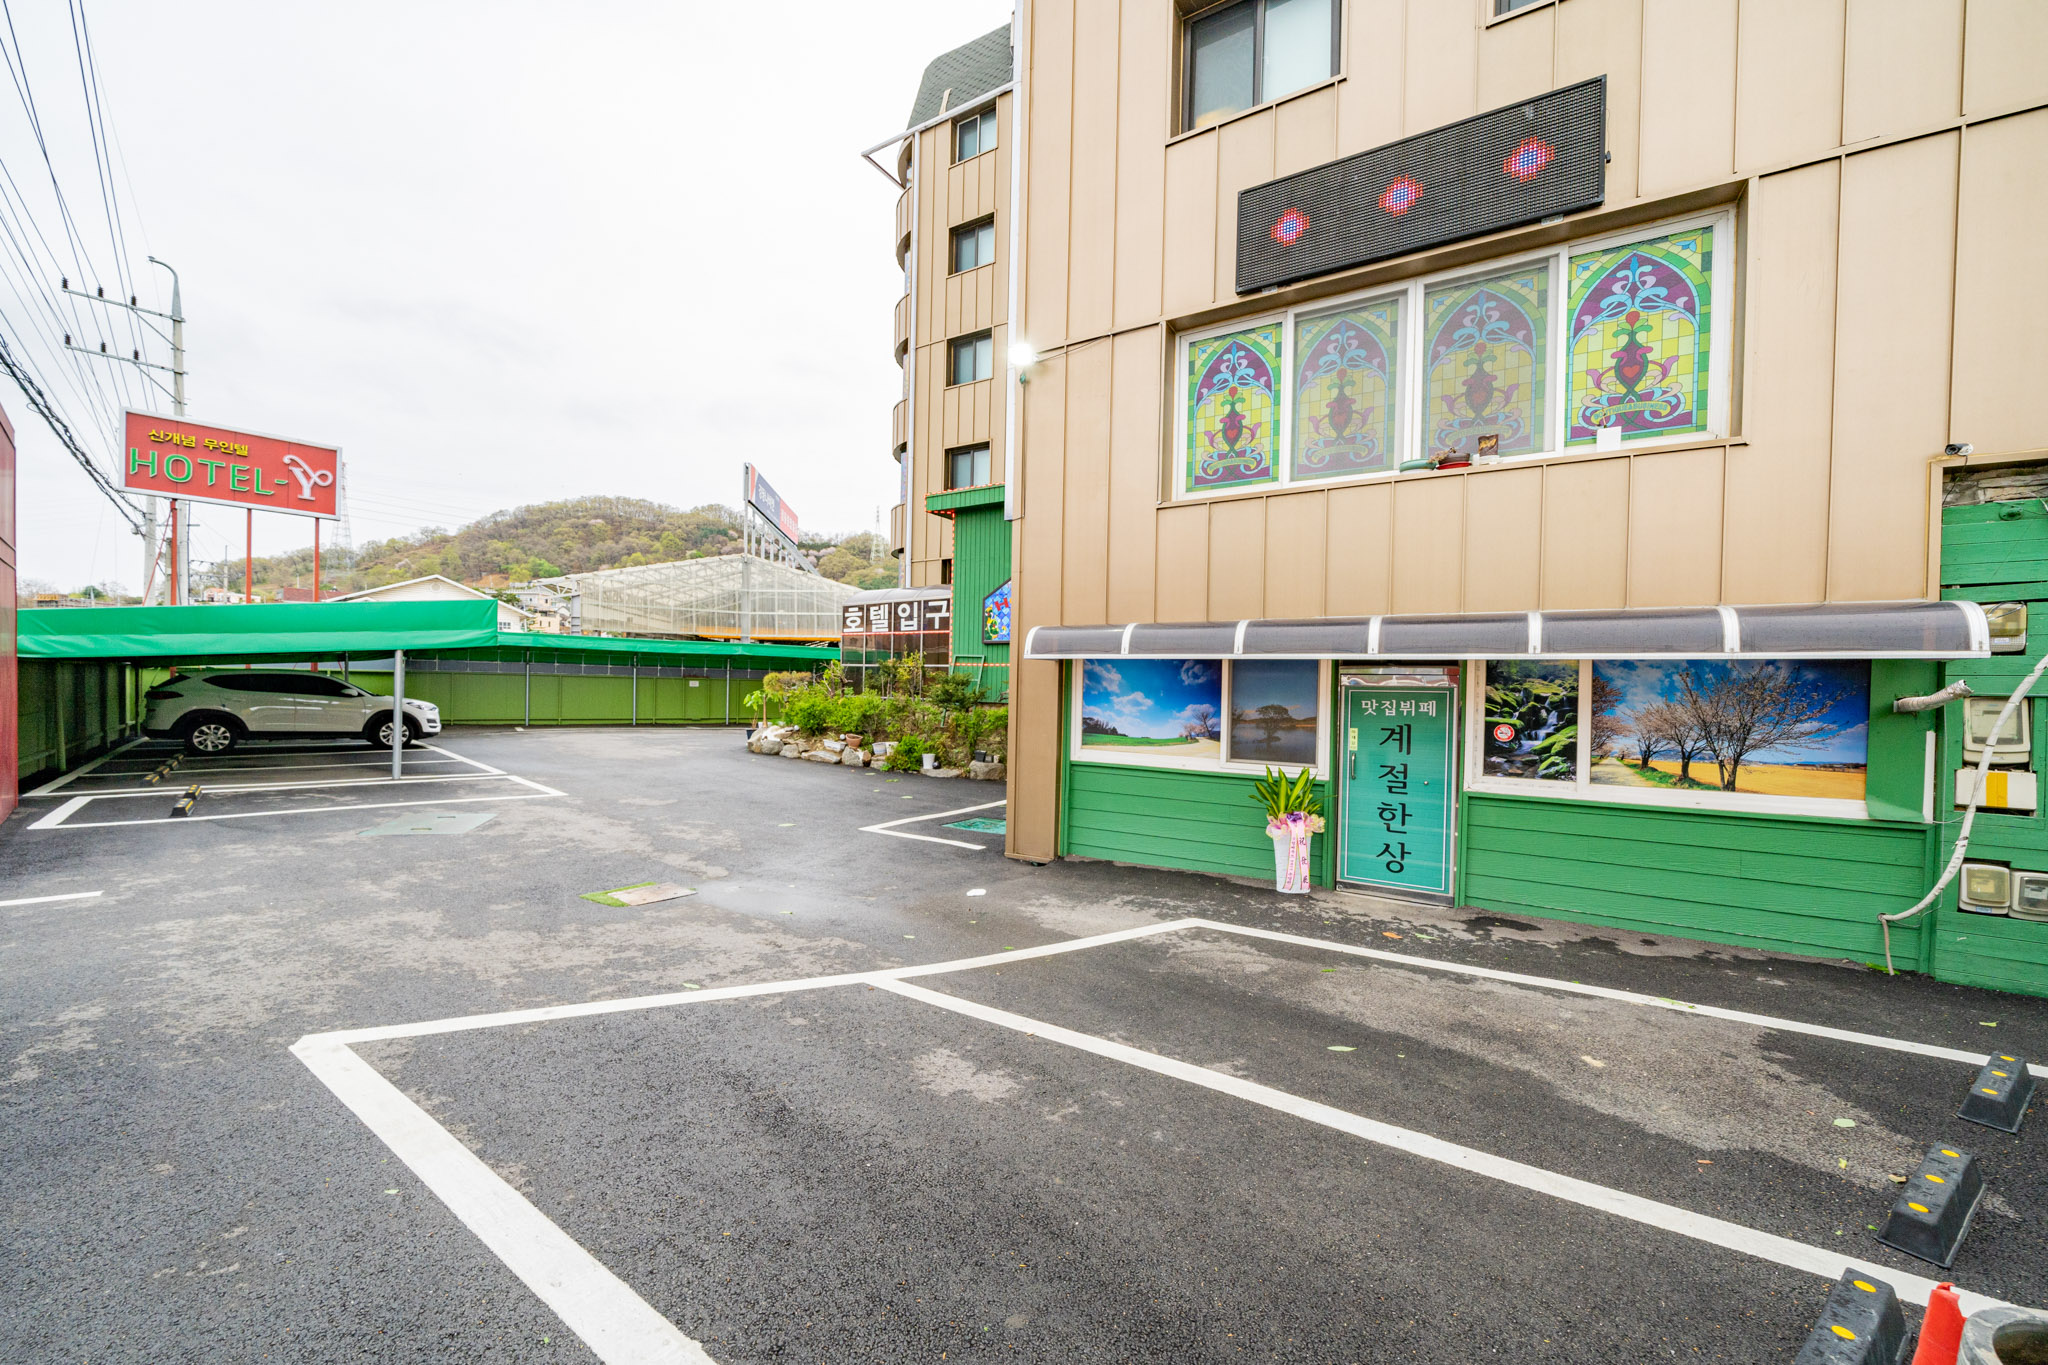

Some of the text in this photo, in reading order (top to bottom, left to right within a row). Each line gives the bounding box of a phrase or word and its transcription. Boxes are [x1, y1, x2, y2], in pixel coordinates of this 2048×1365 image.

[148, 429, 249, 457] 신개념 무인텔
[843, 600, 950, 633] 호텔입구
[1361, 699, 1437, 718] 맛집뷔페
[1376, 723, 1413, 874] 계절한상
